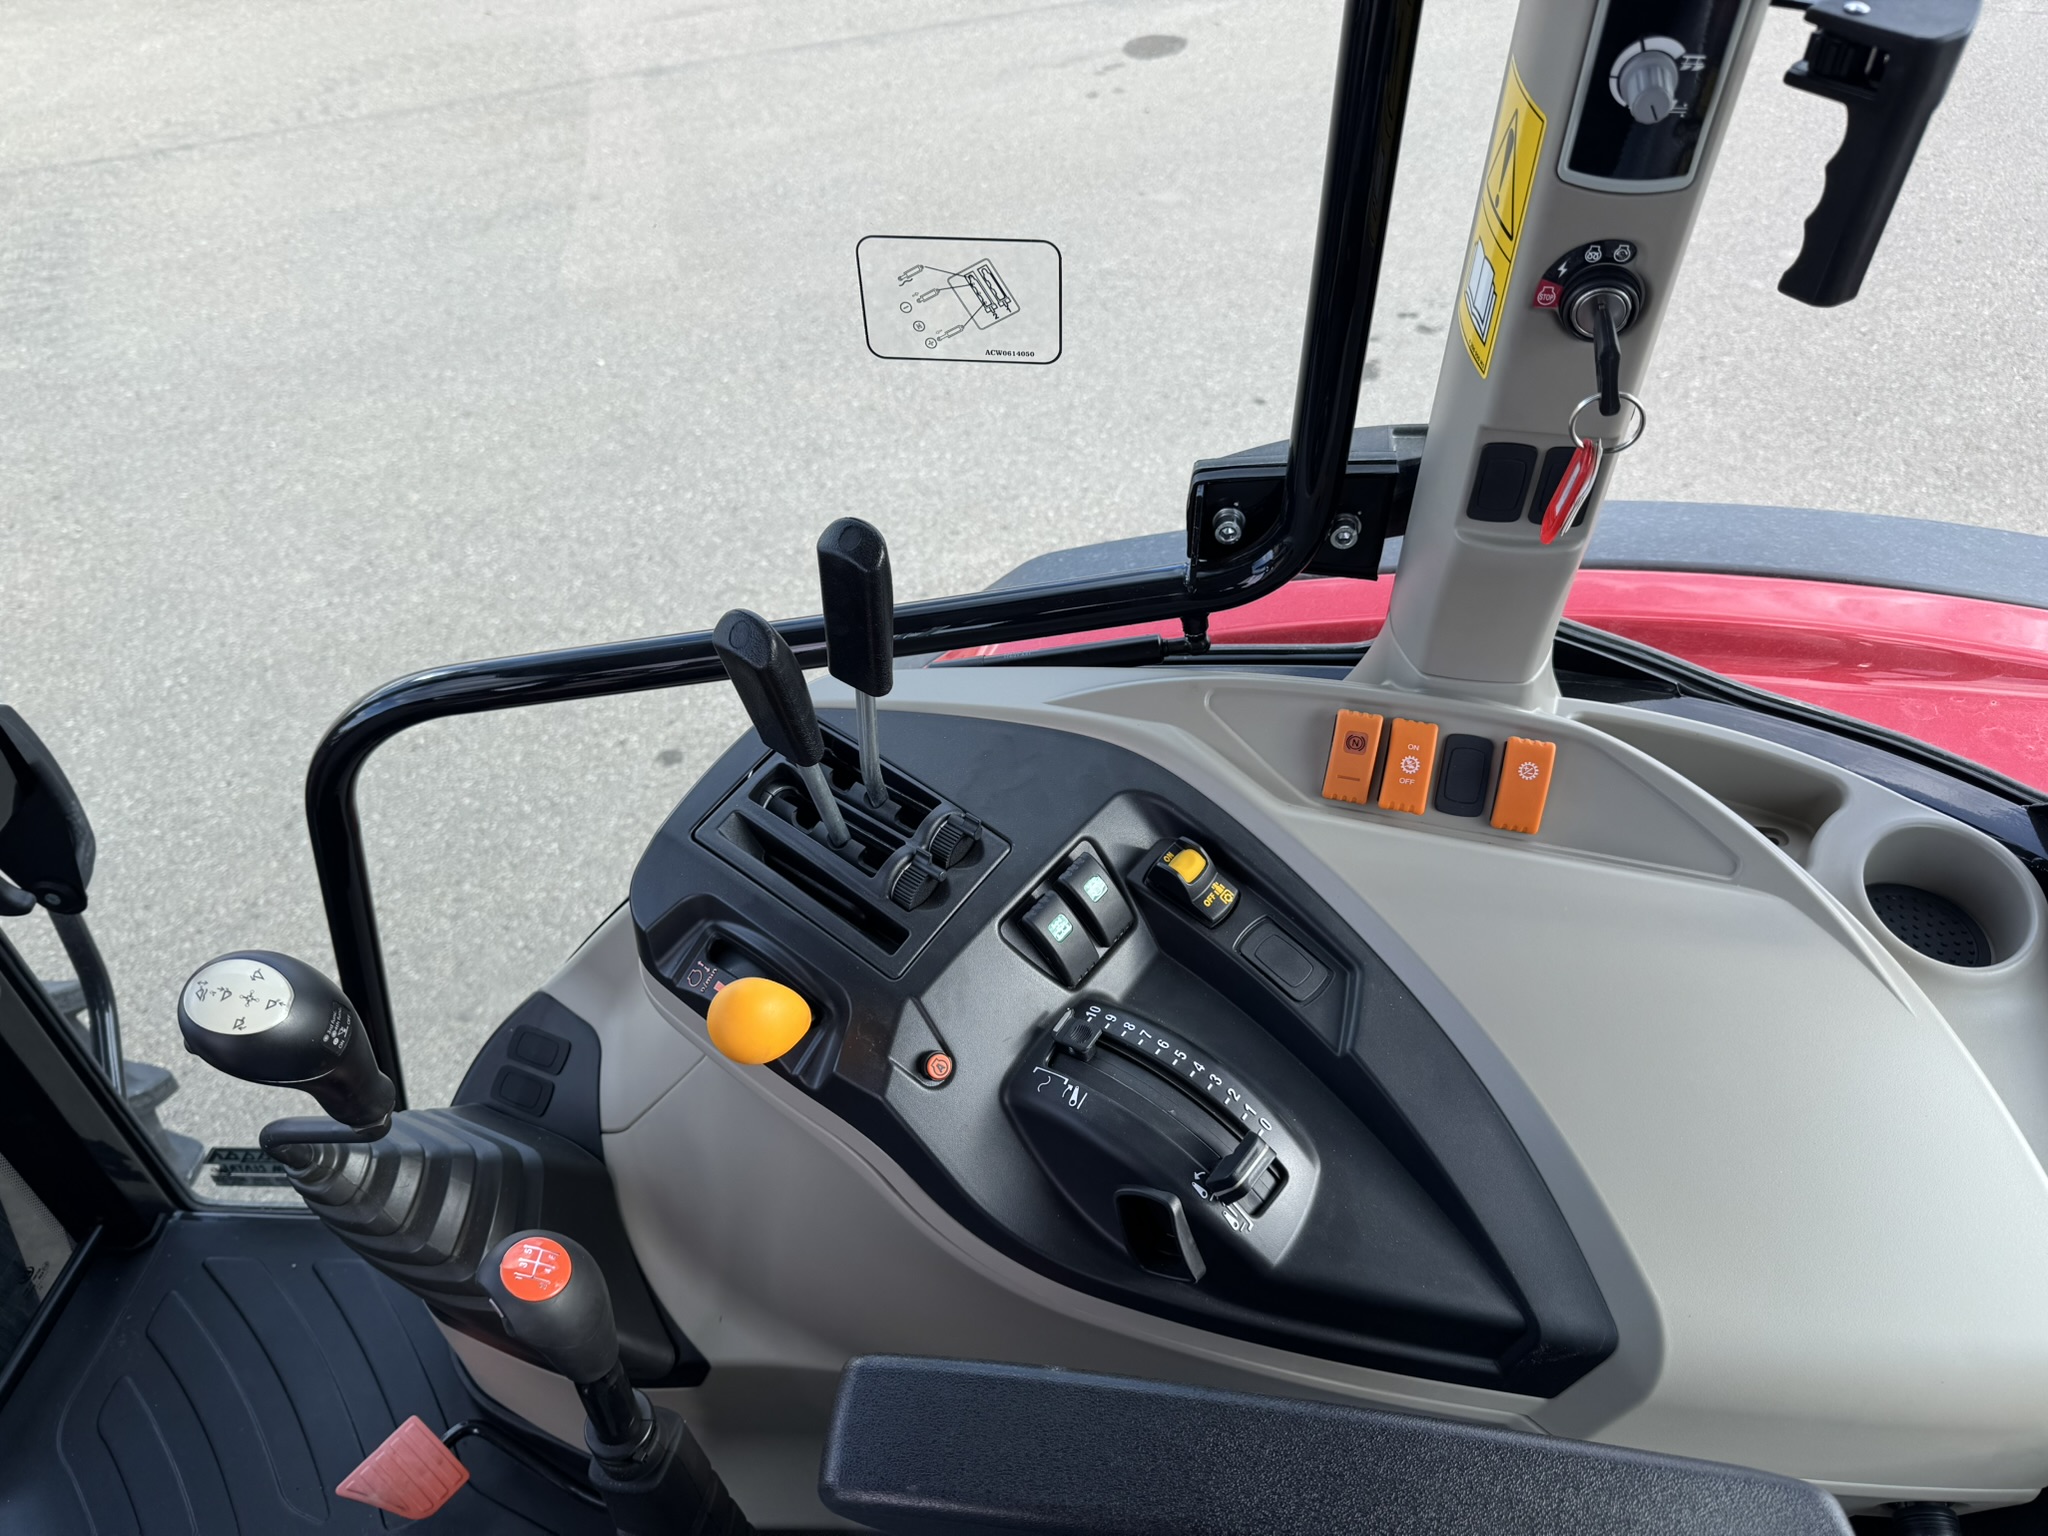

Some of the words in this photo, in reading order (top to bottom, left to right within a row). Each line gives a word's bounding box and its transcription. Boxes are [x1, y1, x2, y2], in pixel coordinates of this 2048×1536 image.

[1538, 293, 1554, 301] STOP
[985, 349, 1034, 357] ACW0614050
[1351, 739, 1359, 747] N
[1407, 743, 1420, 751] ON
[1399, 777, 1415, 785] OFF
[1163, 851, 1174, 862] ON
[1203, 893, 1215, 907] OFF
[1086, 1005, 1101, 1018] 10
[1105, 1014, 1117, 1023] 9
[1123, 1022, 1136, 1031] 8
[1139, 1029, 1152, 1039] 7
[1157, 1039, 1170, 1049] 6
[1174, 1049, 1187, 1060] 5
[1193, 1060, 1206, 1072] 4
[1209, 1073, 1222, 1085] 3
[1227, 1087, 1241, 1101] 2
[1244, 1103, 1257, 1116] 1
[1259, 1117, 1272, 1131] 0
